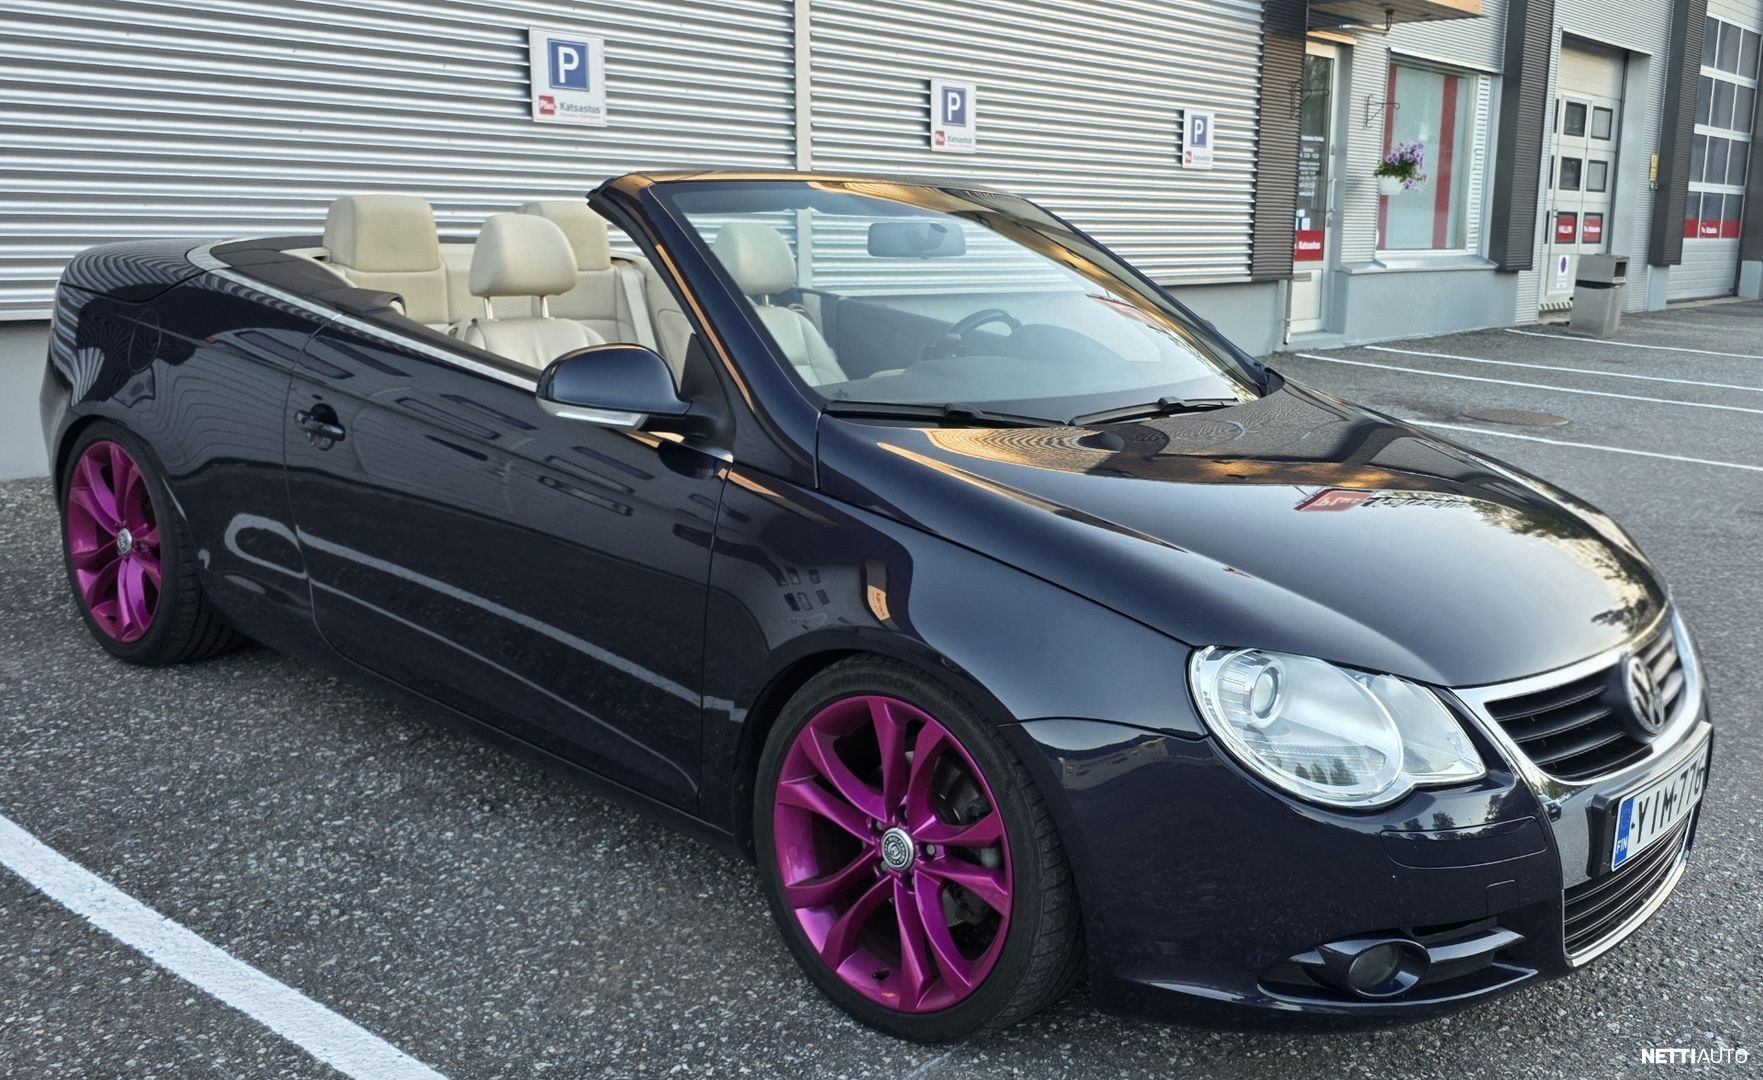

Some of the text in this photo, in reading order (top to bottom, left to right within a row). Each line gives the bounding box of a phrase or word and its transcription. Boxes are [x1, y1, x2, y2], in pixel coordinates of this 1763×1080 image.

[557, 46, 579, 84] P
[560, 101, 600, 113] Katsastus
[947, 92, 961, 121] P
[1194, 119, 1204, 144] P
[1636, 751, 1706, 845] YIM-776
[1616, 835, 1629, 855] FIN
